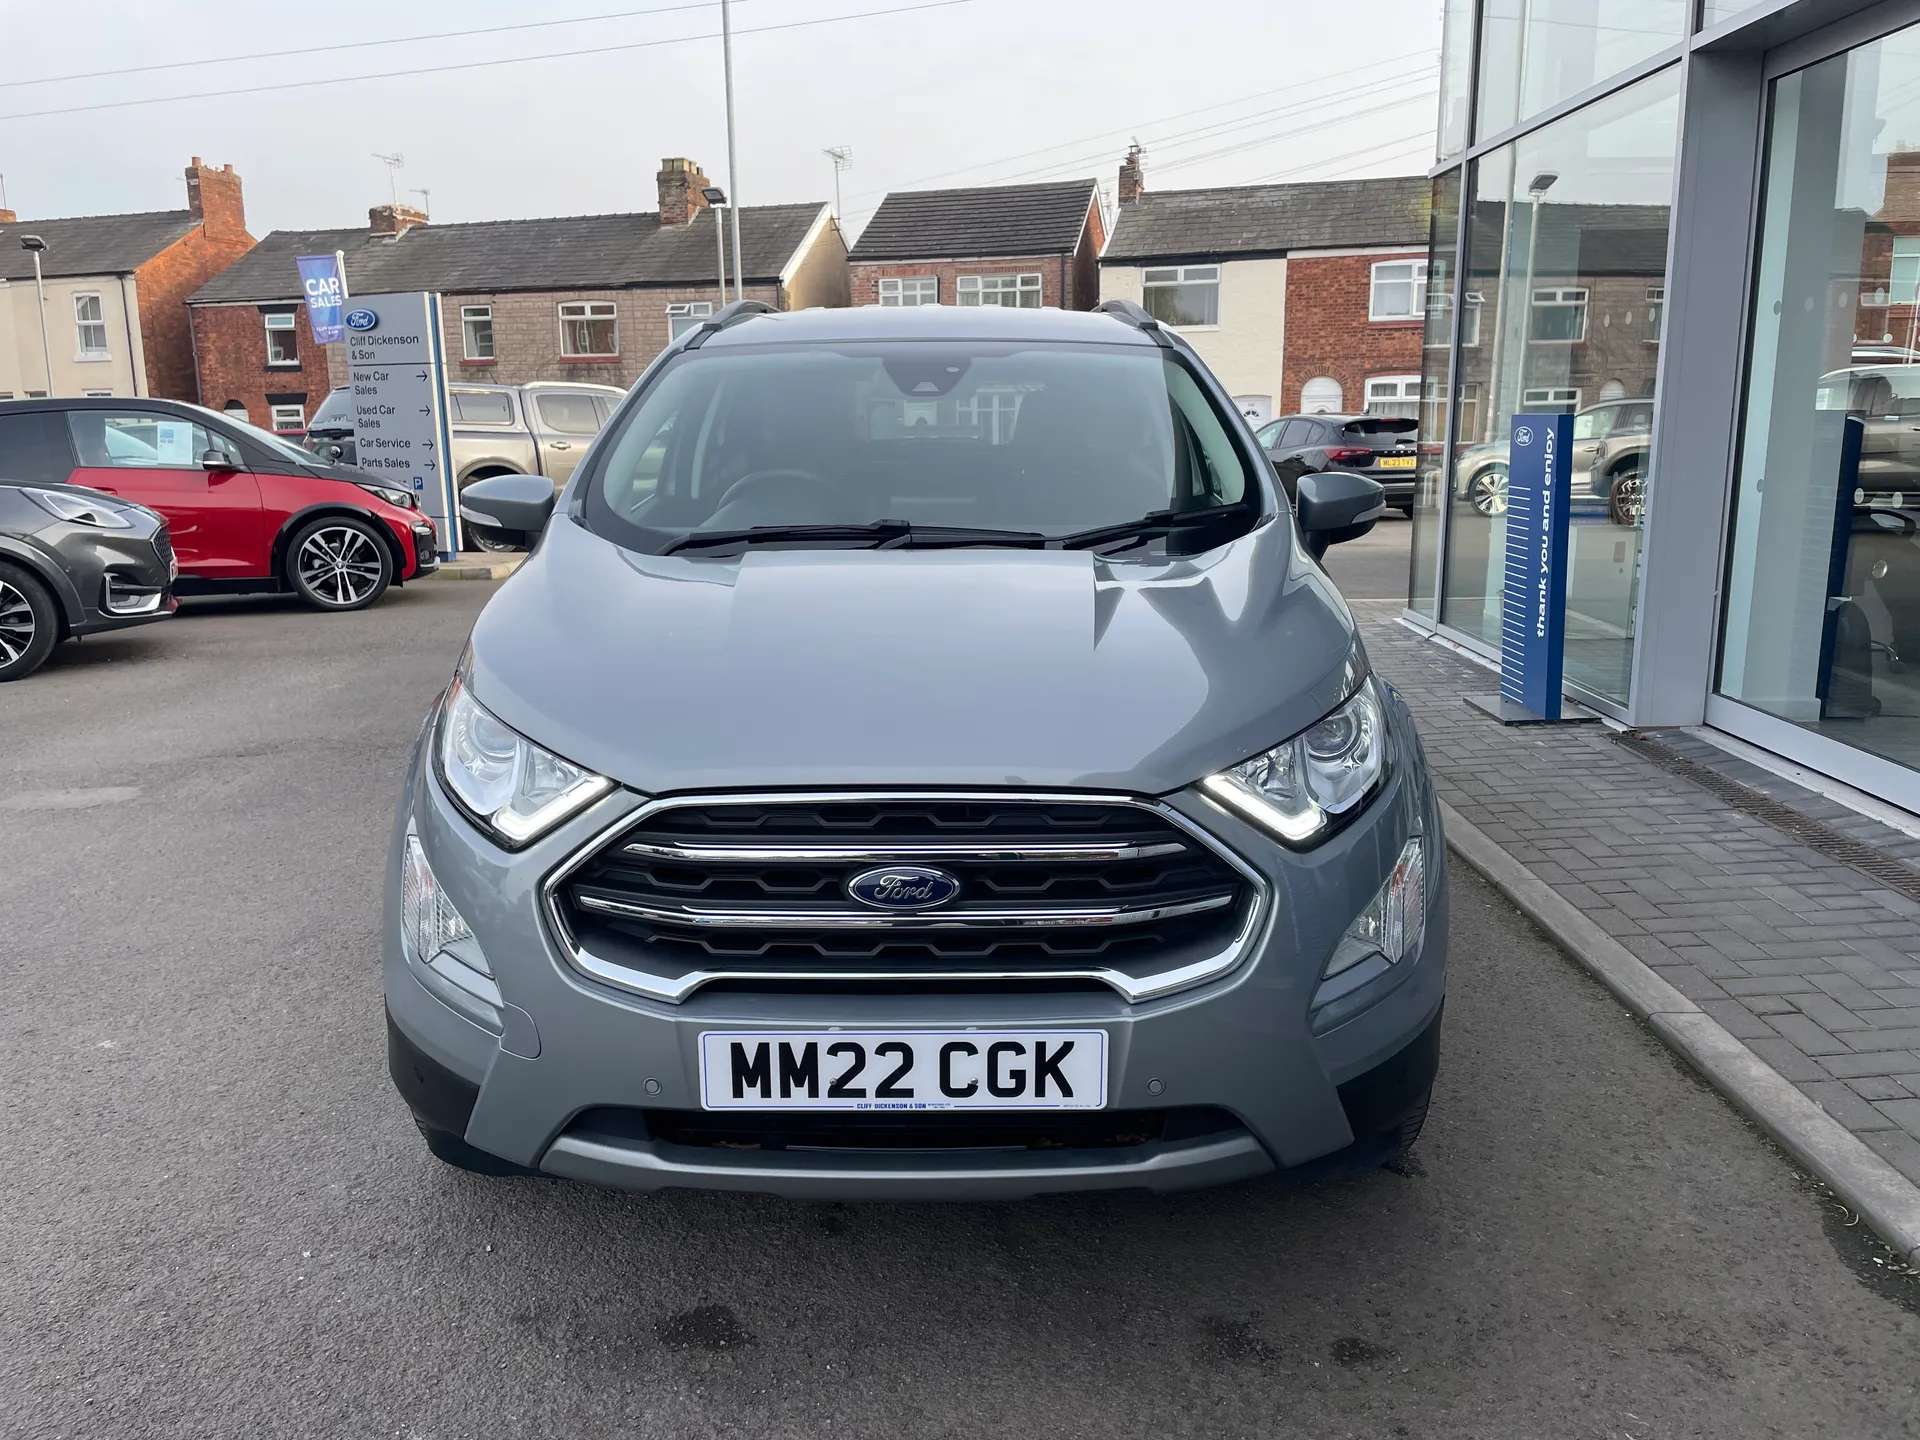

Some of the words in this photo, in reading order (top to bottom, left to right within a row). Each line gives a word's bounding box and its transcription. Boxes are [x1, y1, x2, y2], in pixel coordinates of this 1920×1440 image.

[306, 277, 340, 296] CAR
[310, 294, 343, 309] SALES
[350, 335, 366, 347] Cliff
[368, 334, 419, 346] Dickenson
[351, 350, 358, 360] &
[358, 349, 376, 360] Son
[353, 371, 371, 382] New
[373, 370, 390, 381] Car
[354, 384, 378, 396] Sales
[356, 404, 378, 415] Used
[379, 404, 396, 415] Car
[358, 418, 381, 429] Sales
[360, 437, 375, 448] Car
[376, 437, 411, 448] Service
[361, 456, 383, 468] Parts
[384, 457, 411, 468] Sales
[1544, 427, 1555, 487] enjoy
[1542, 490, 1551, 532] and
[1540, 535, 1549, 574] you
[1536, 577, 1547, 638] thank
[730, 1042, 914, 1099] MM22
[939, 1041, 1075, 1098] CGK
